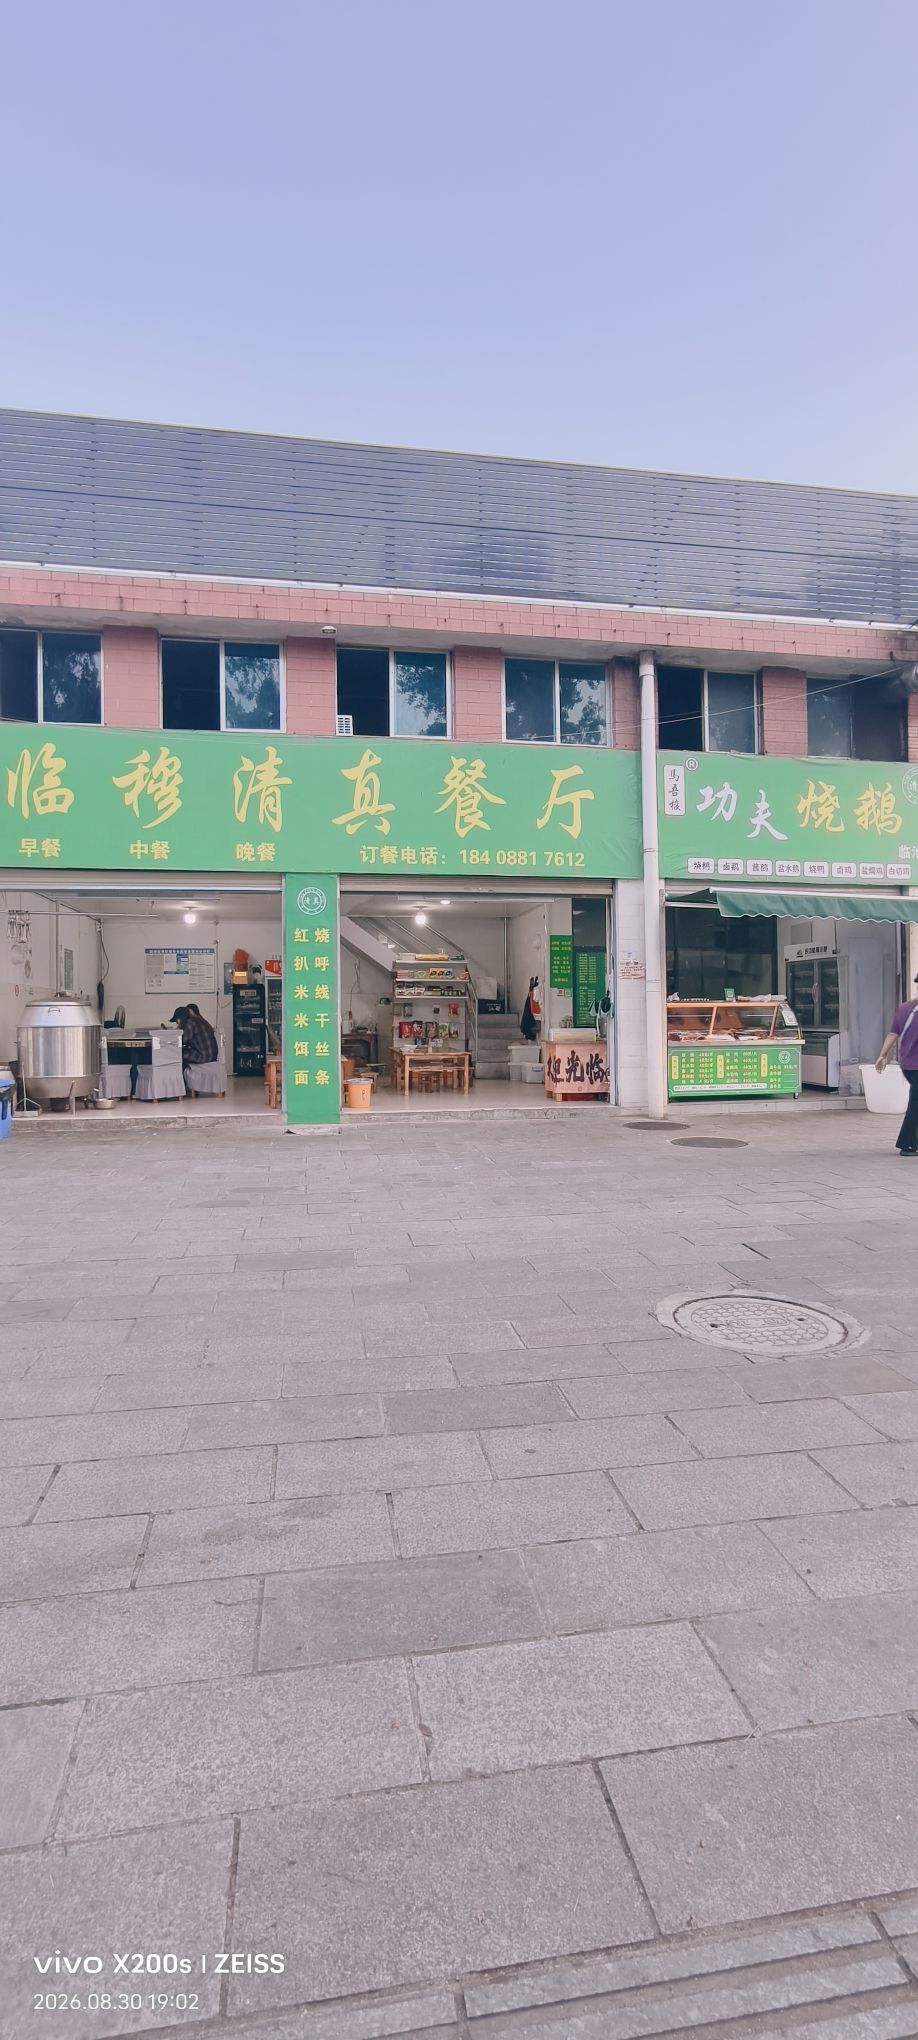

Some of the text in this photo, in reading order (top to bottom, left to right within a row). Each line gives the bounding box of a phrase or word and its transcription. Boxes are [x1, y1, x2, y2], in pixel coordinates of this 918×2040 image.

[6, 742, 595, 839] 临穆清真餐厅
[696, 779, 903, 841] 功夫烧鹅
[19, 838, 61, 858] 早餐
[129, 840, 171, 860] 中餐
[236, 842, 276, 862] 晚餐
[459, 849, 490, 865] 184
[496, 849, 537, 866] 0881
[544, 851, 585, 867] 7612
